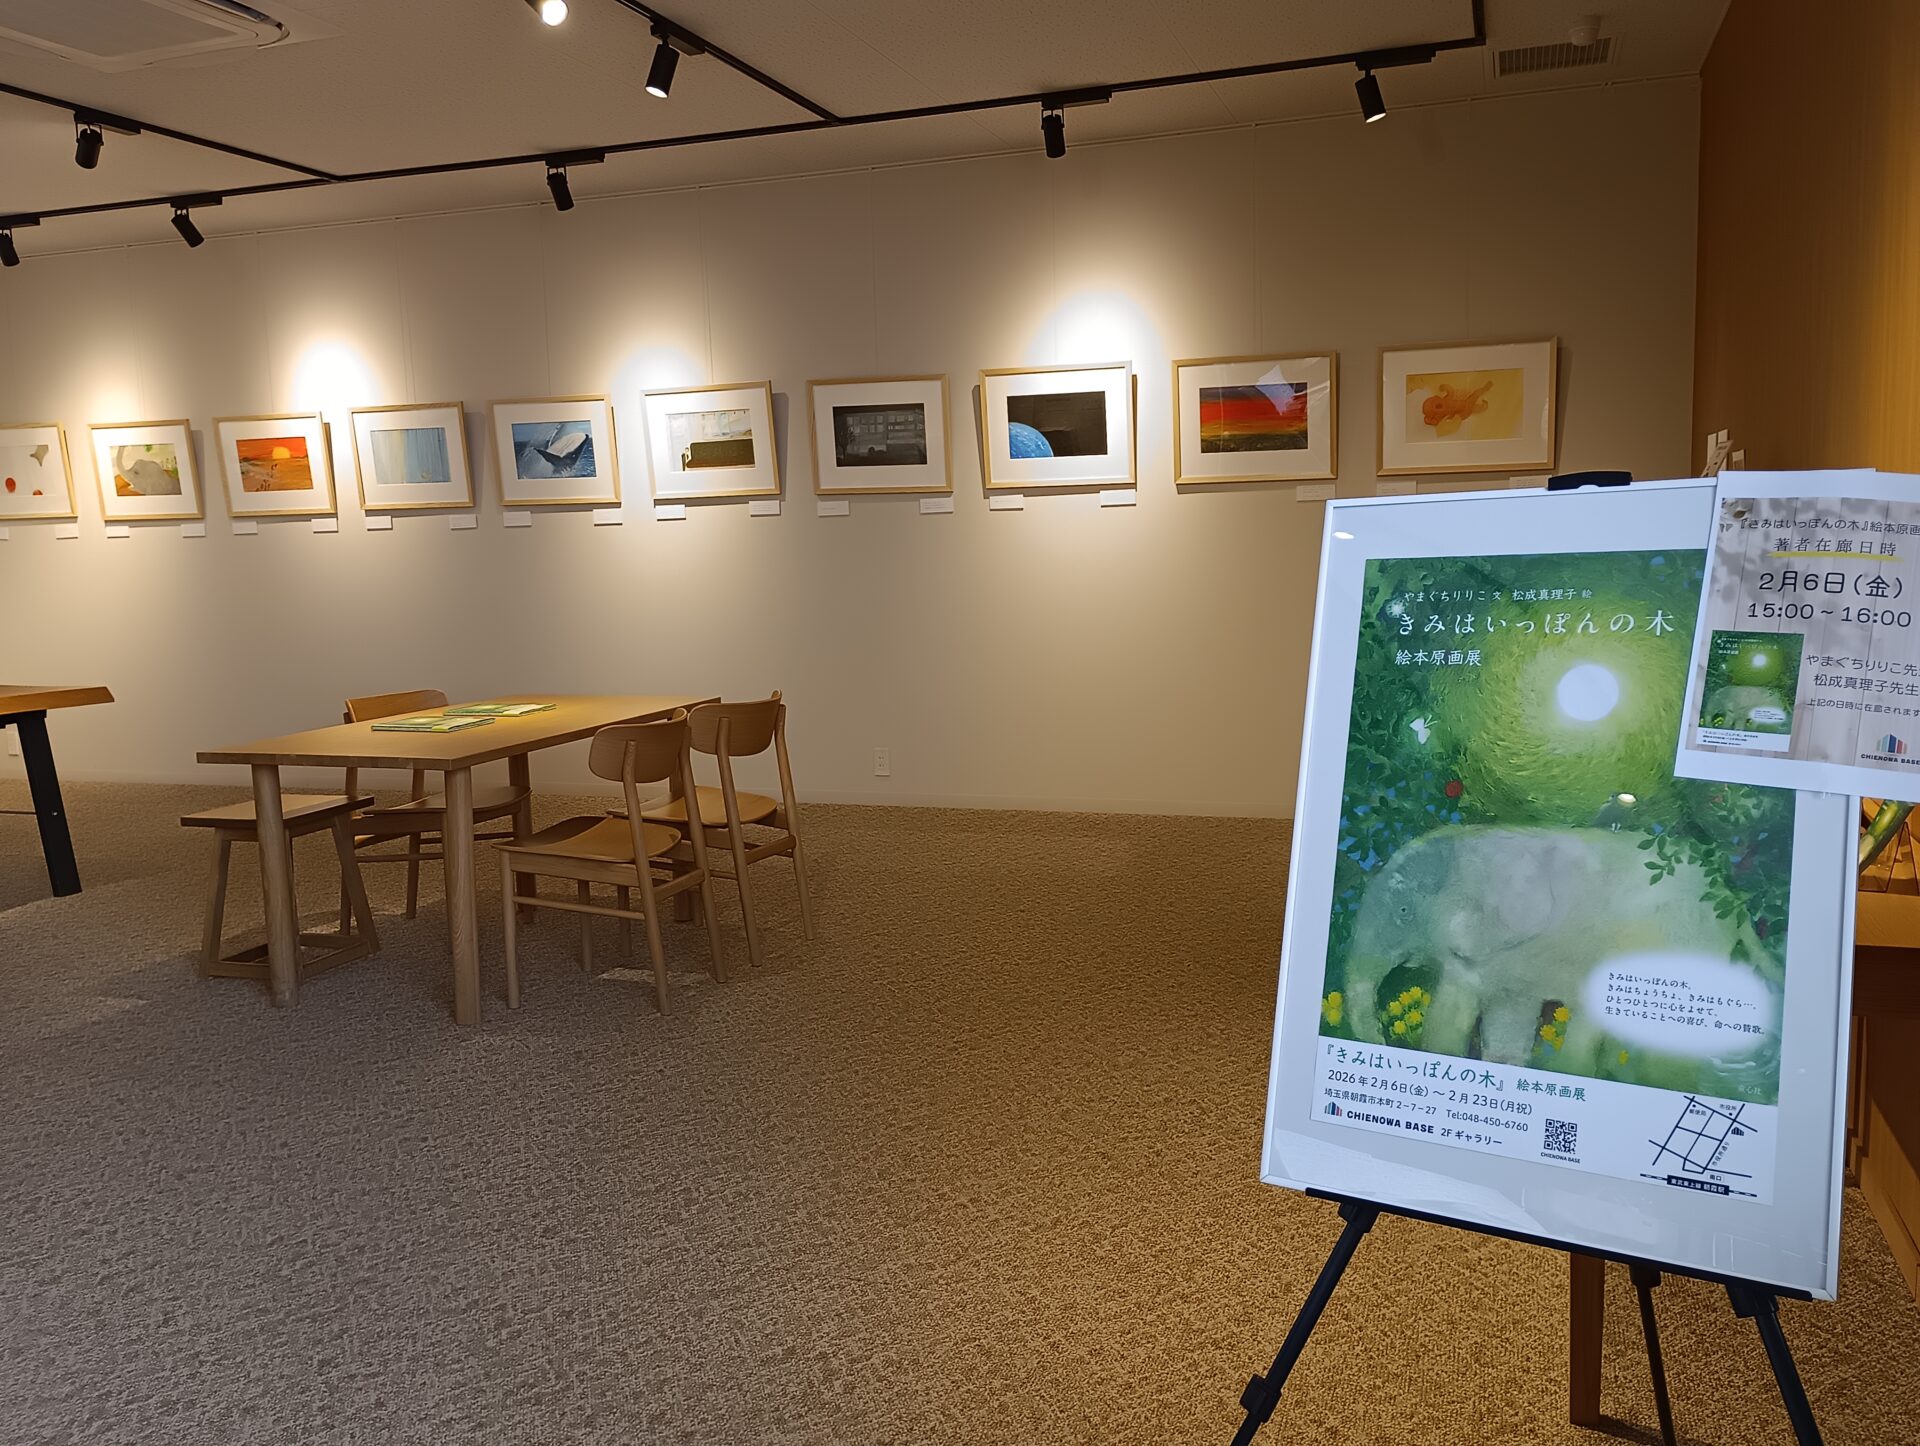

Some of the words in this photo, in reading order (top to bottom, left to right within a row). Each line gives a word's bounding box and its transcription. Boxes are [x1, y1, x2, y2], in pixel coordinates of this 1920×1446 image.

[1774, 538, 1896, 557] 著者在廊日時
[1403, 590, 1486, 602] やまぐちりりこ
[1492, 592, 1502, 601] 文
[1511, 588, 1577, 601] 松成真理子
[1582, 590, 1593, 600] 絵
[1759, 570, 1903, 599] 2月6日(金)
[1399, 609, 1674, 636] きみはいっぽんの木
[1395, 650, 1482, 666] 絵本原画展
[1813, 673, 1919, 697] 松成真理子先生
[1860, 753, 1898, 763] CHIENOWA
[1327, 1044, 1504, 1092] 『きみはいっぽんの木』
[1516, 1078, 1587, 1102] 絵本原画展
[1346, 1110, 1401, 1128] CHIENOWA
[1405, 1121, 1434, 1134] BASE
[1446, 1109, 1529, 1132] Tel:048-450-6760
[1540, 1152, 1567, 1161] CHIENOWA
